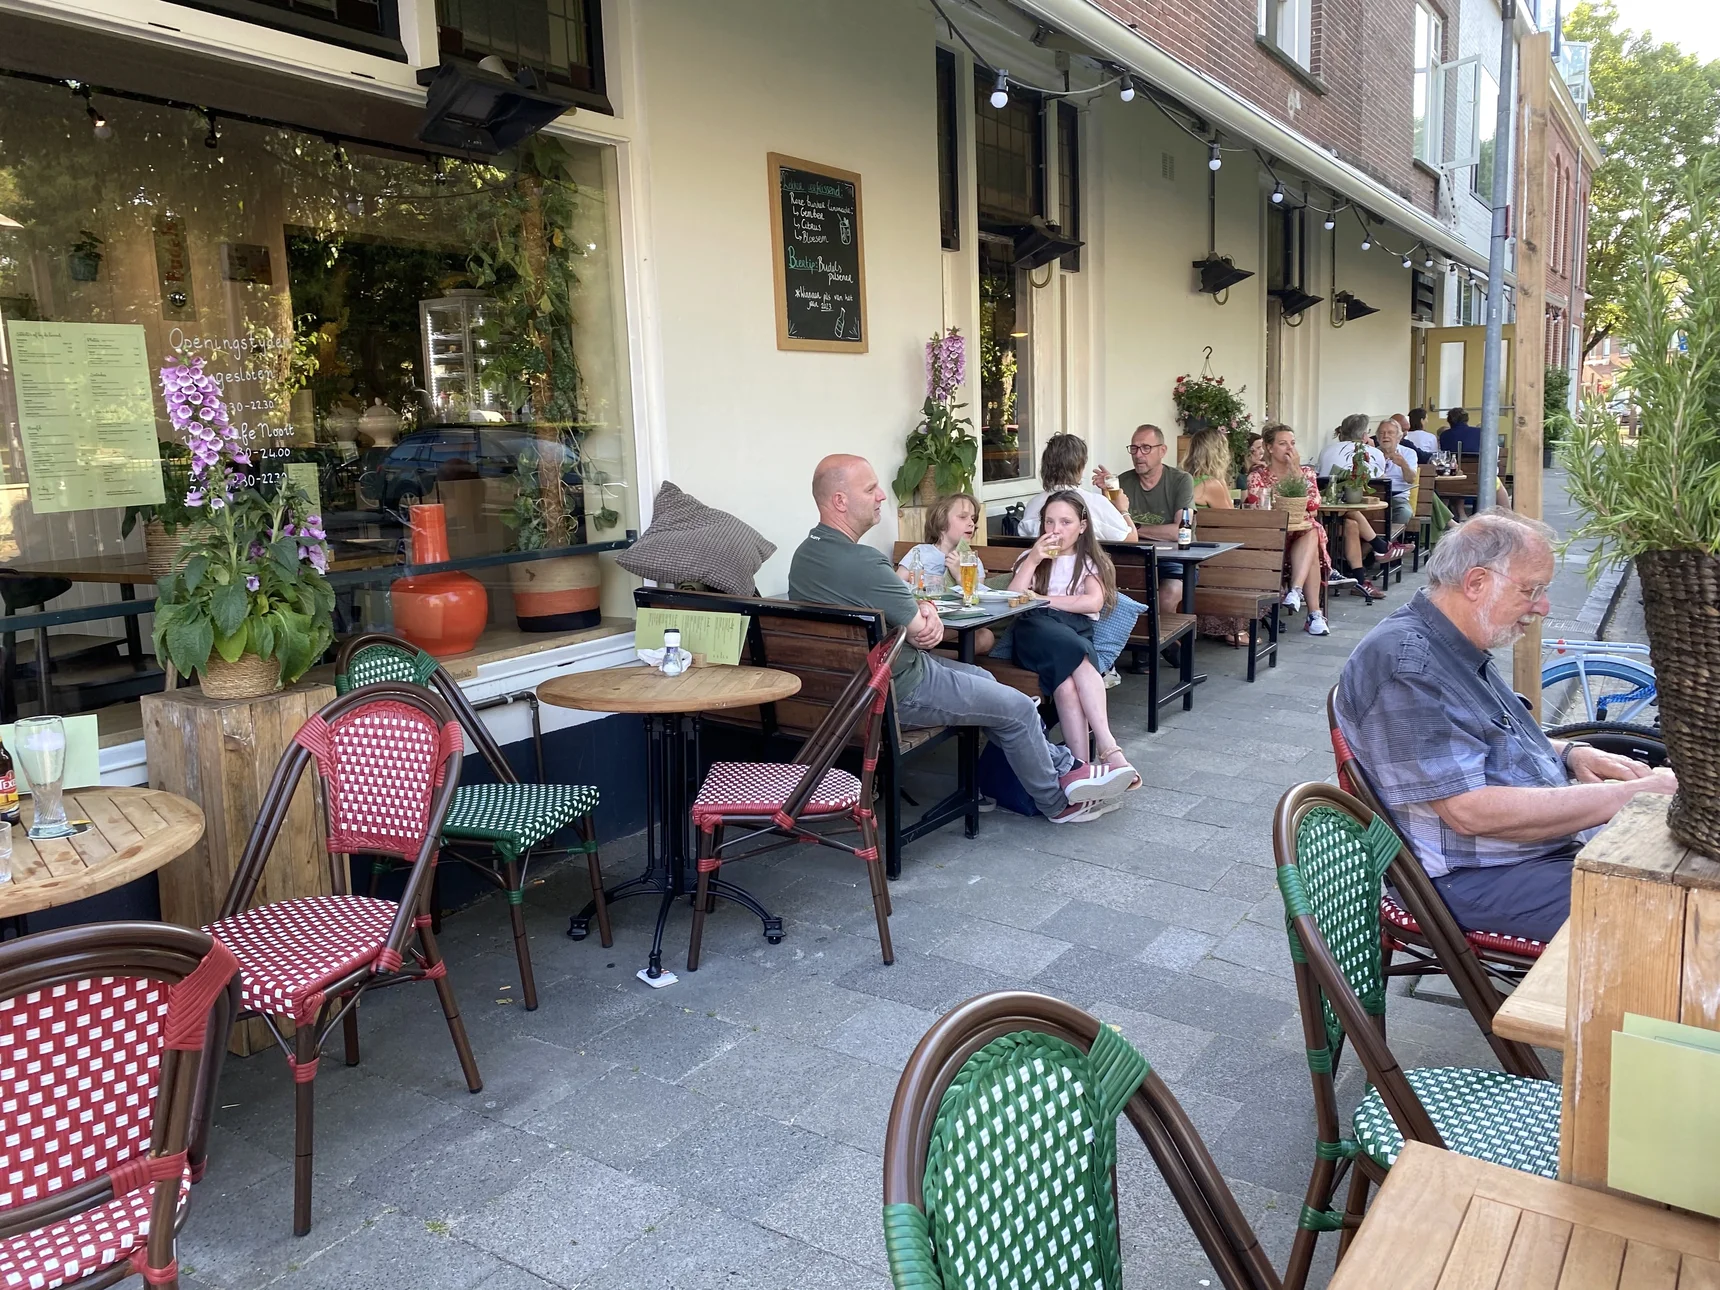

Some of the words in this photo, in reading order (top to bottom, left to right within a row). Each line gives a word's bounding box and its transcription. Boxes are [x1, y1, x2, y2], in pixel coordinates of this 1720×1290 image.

[800, 207, 825, 221] Gember
[801, 218, 822, 232] Citrus
[802, 230, 829, 244] Bloesem
[817, 255, 843, 273] Budels
